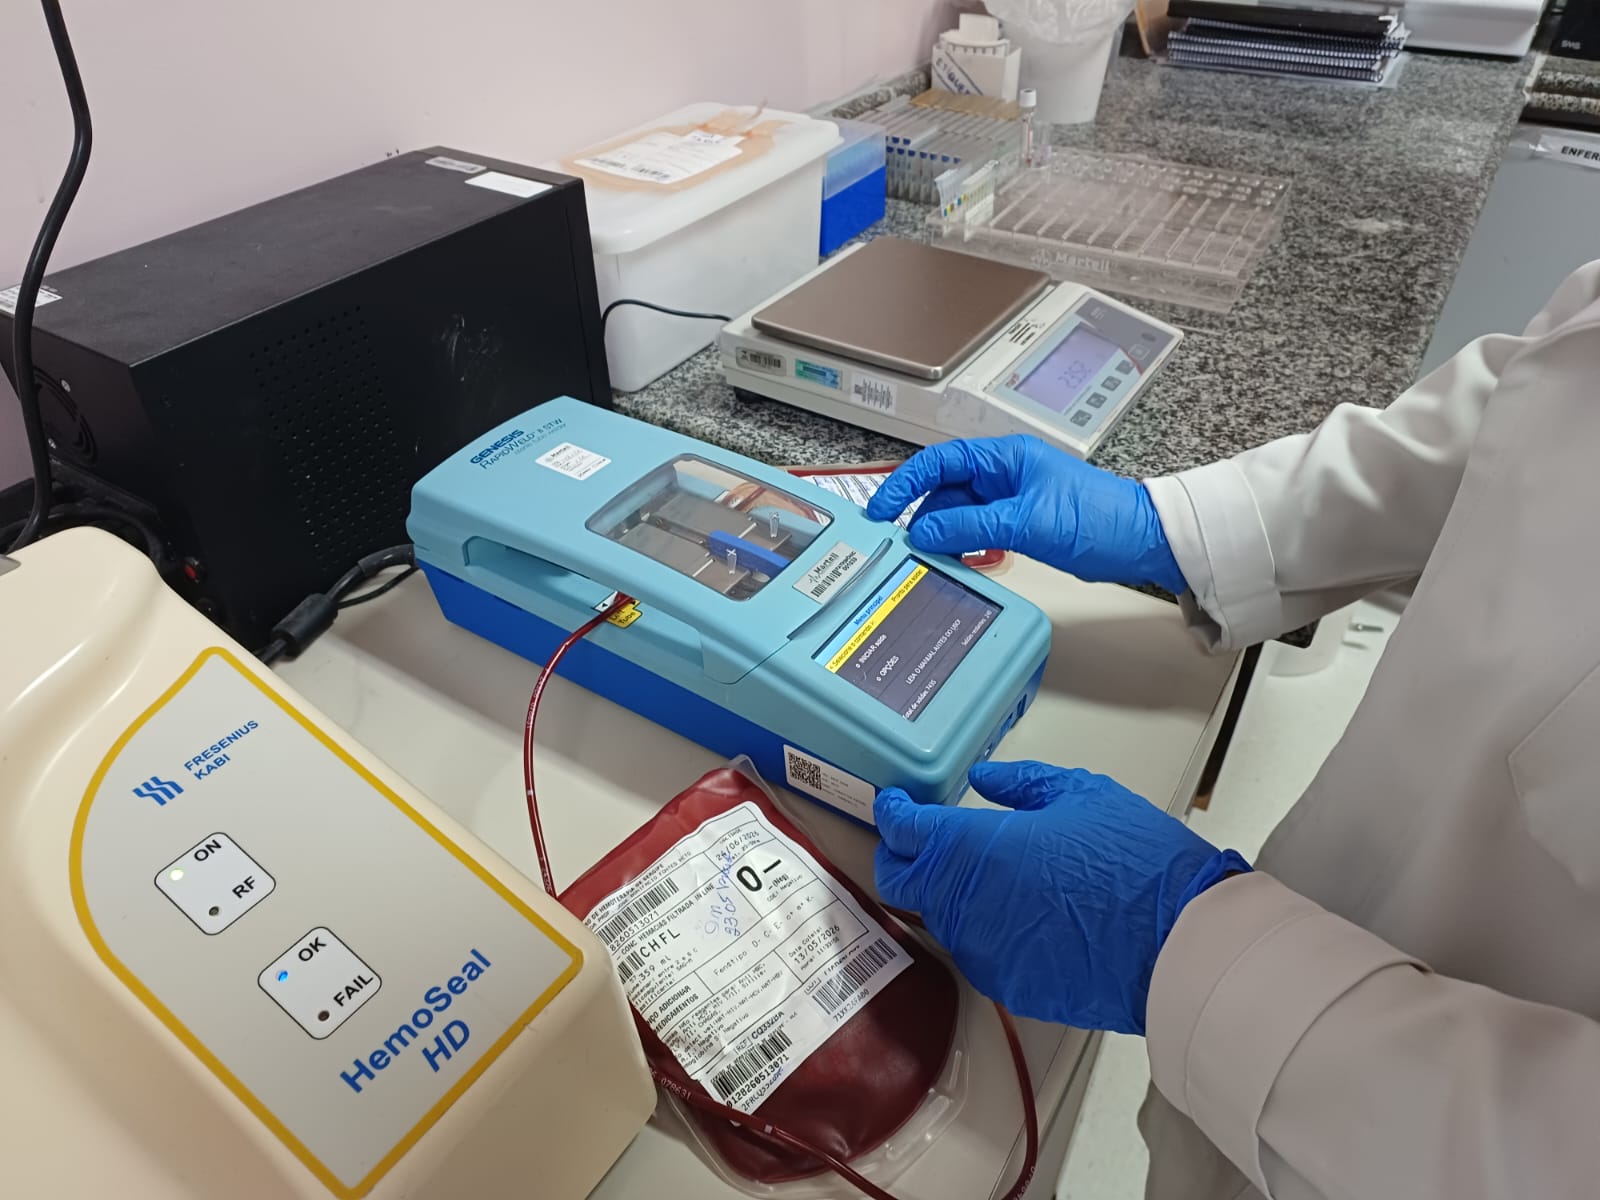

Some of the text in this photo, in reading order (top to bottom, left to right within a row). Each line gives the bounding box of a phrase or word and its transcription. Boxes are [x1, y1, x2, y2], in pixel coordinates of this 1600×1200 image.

[470, 427, 523, 464] GENESIS
[814, 552, 838, 574] Martell
[184, 719, 259, 773] FRESENIUS
[193, 752, 231, 781] KABI
[193, 839, 222, 863] ON
[232, 875, 257, 901] RF
[298, 937, 327, 963] OK
[794, 924, 839, 963] 13/05/2026
[333, 972, 374, 1008] FAIL
[339, 948, 493, 1094] HemoSeal
[422, 1018, 472, 1073] HD
